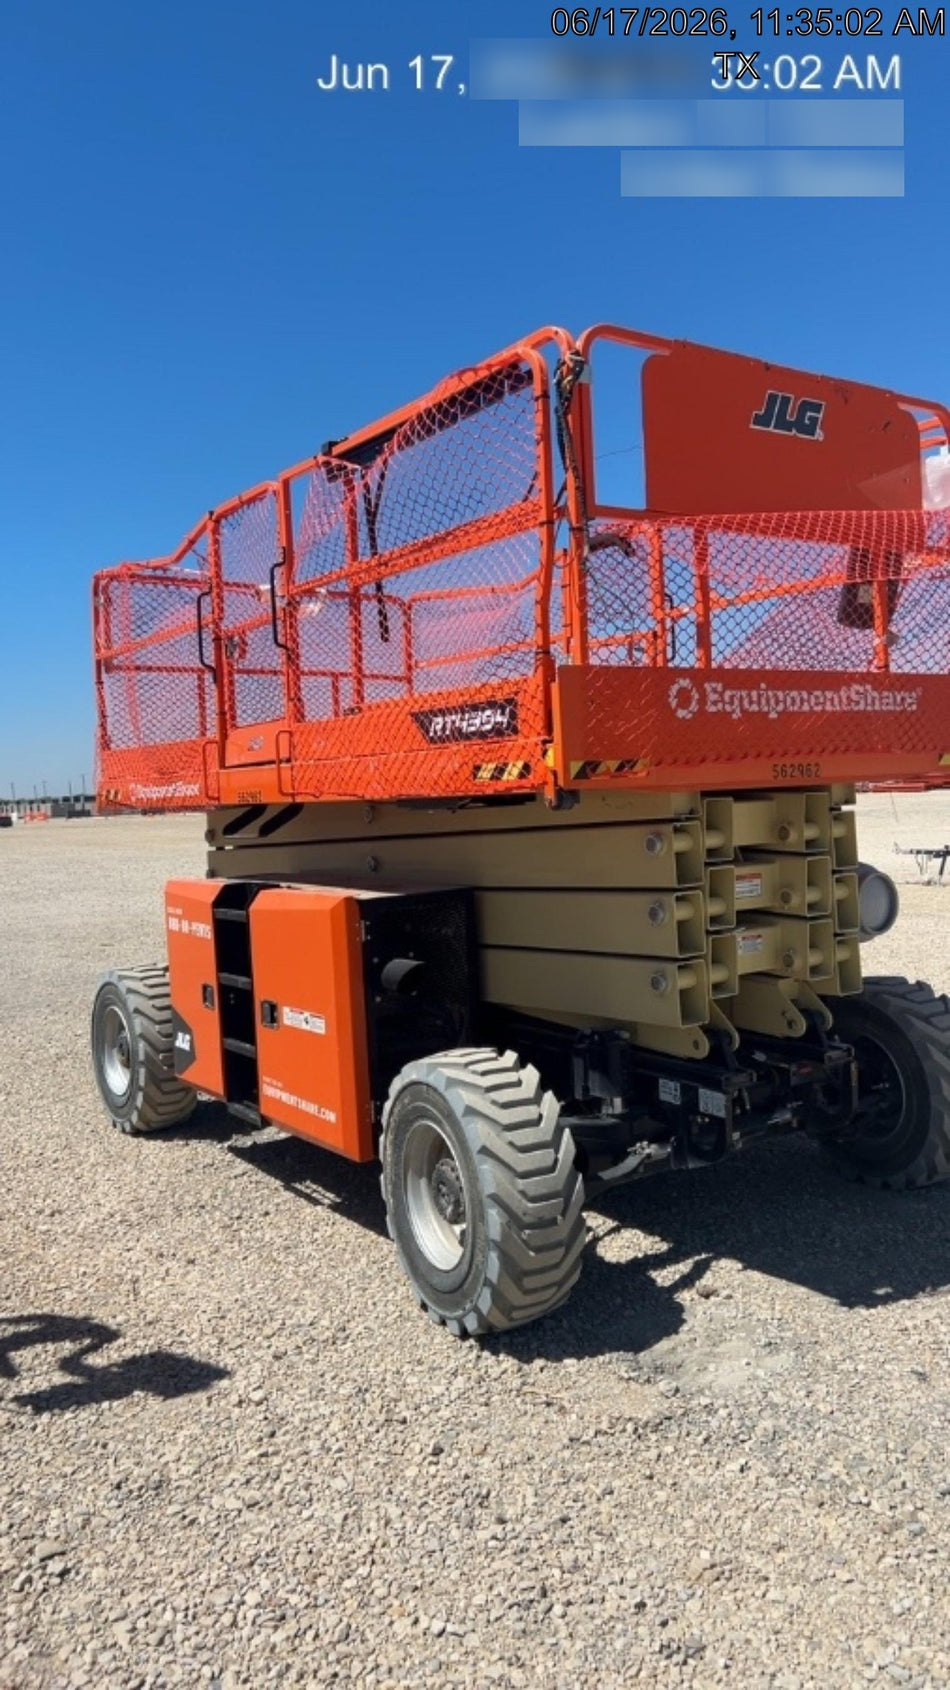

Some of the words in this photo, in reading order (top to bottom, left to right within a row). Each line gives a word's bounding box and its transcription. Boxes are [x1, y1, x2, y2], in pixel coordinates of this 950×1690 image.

[749, 390, 825, 441] JLG
[704, 682, 918, 719] EquipmentShare
[772, 763, 822, 779] 562962
